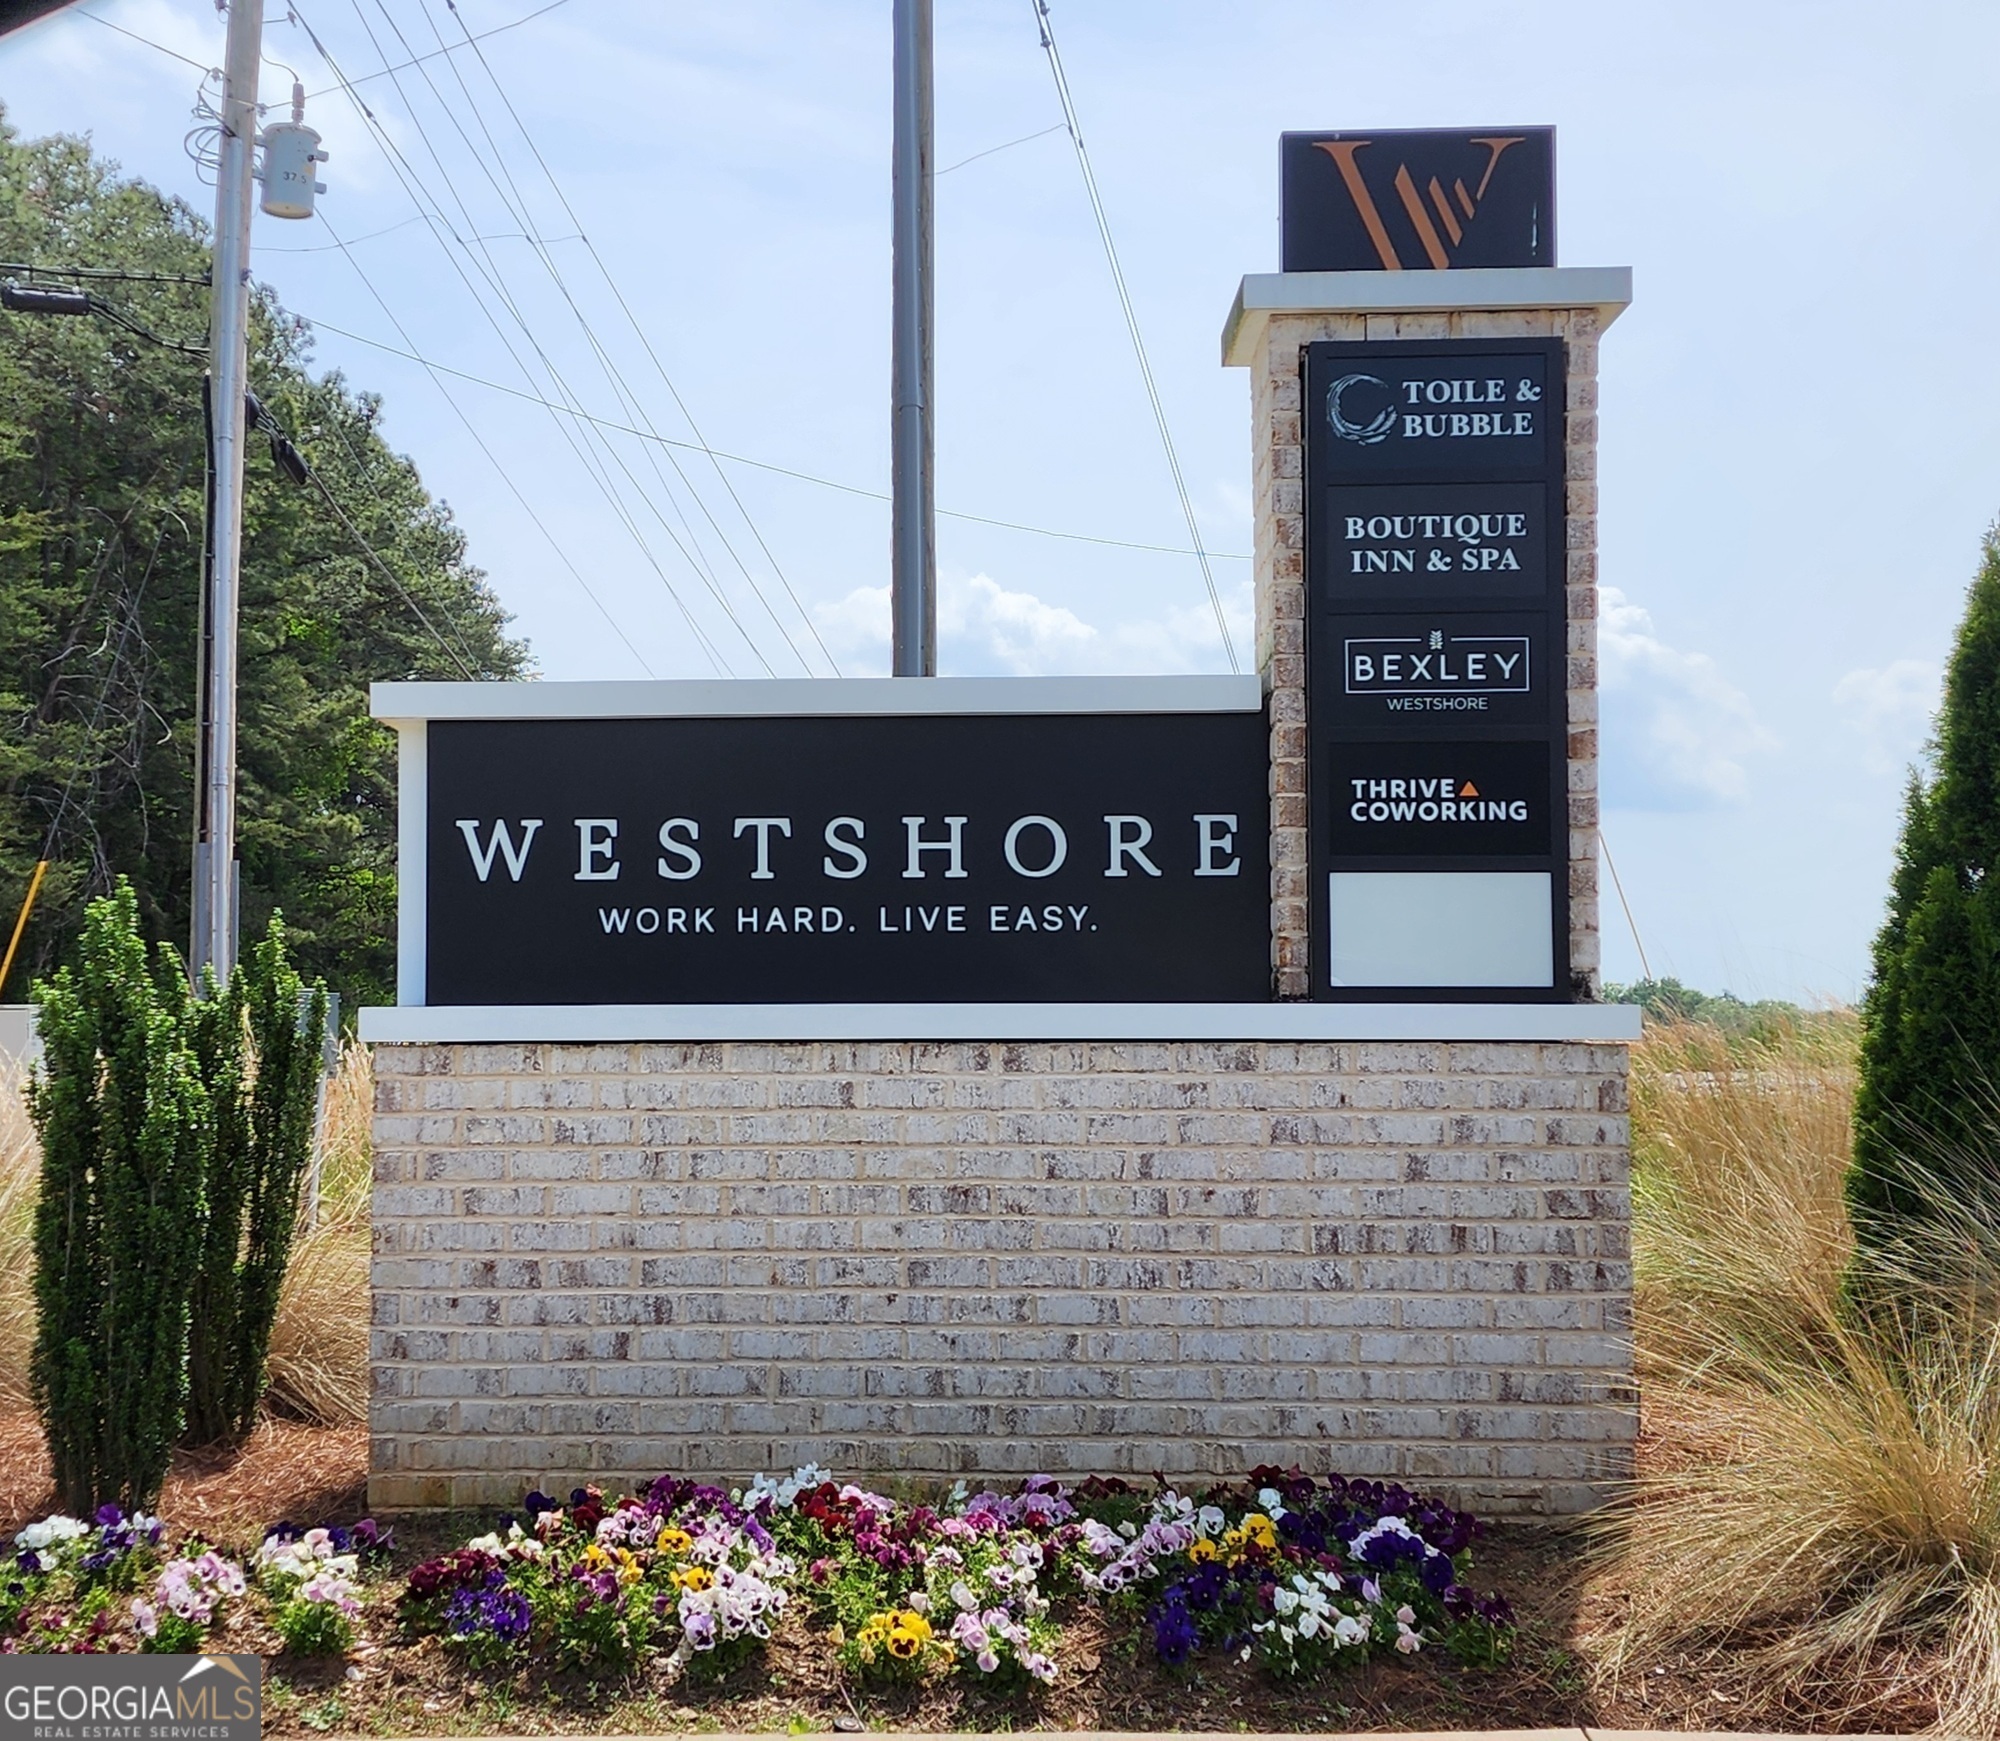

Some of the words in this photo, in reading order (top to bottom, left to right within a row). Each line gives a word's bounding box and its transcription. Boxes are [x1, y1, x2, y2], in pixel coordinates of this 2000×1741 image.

[1402, 378, 1507, 405] TOILE
[1514, 378, 1542, 402] &
[1402, 411, 1534, 438] BUBBLE
[1344, 513, 1528, 546] BOUTIQUE
[1350, 548, 1416, 573] INN
[1426, 548, 1453, 573] &
[1461, 547, 1521, 572] SPA
[1353, 652, 1521, 682] BEXLEY
[1386, 697, 1489, 712] WESTSHORE
[1351, 778, 1455, 799] THRIVE
[1350, 800, 1528, 822] COWORKING
[455, 814, 1241, 882] WESTSHORE
[598, 906, 716, 934] WORK
[737, 906, 856, 933] HARD.
[880, 905, 968, 932] LIVE
[990, 905, 1098, 931] EASY.
